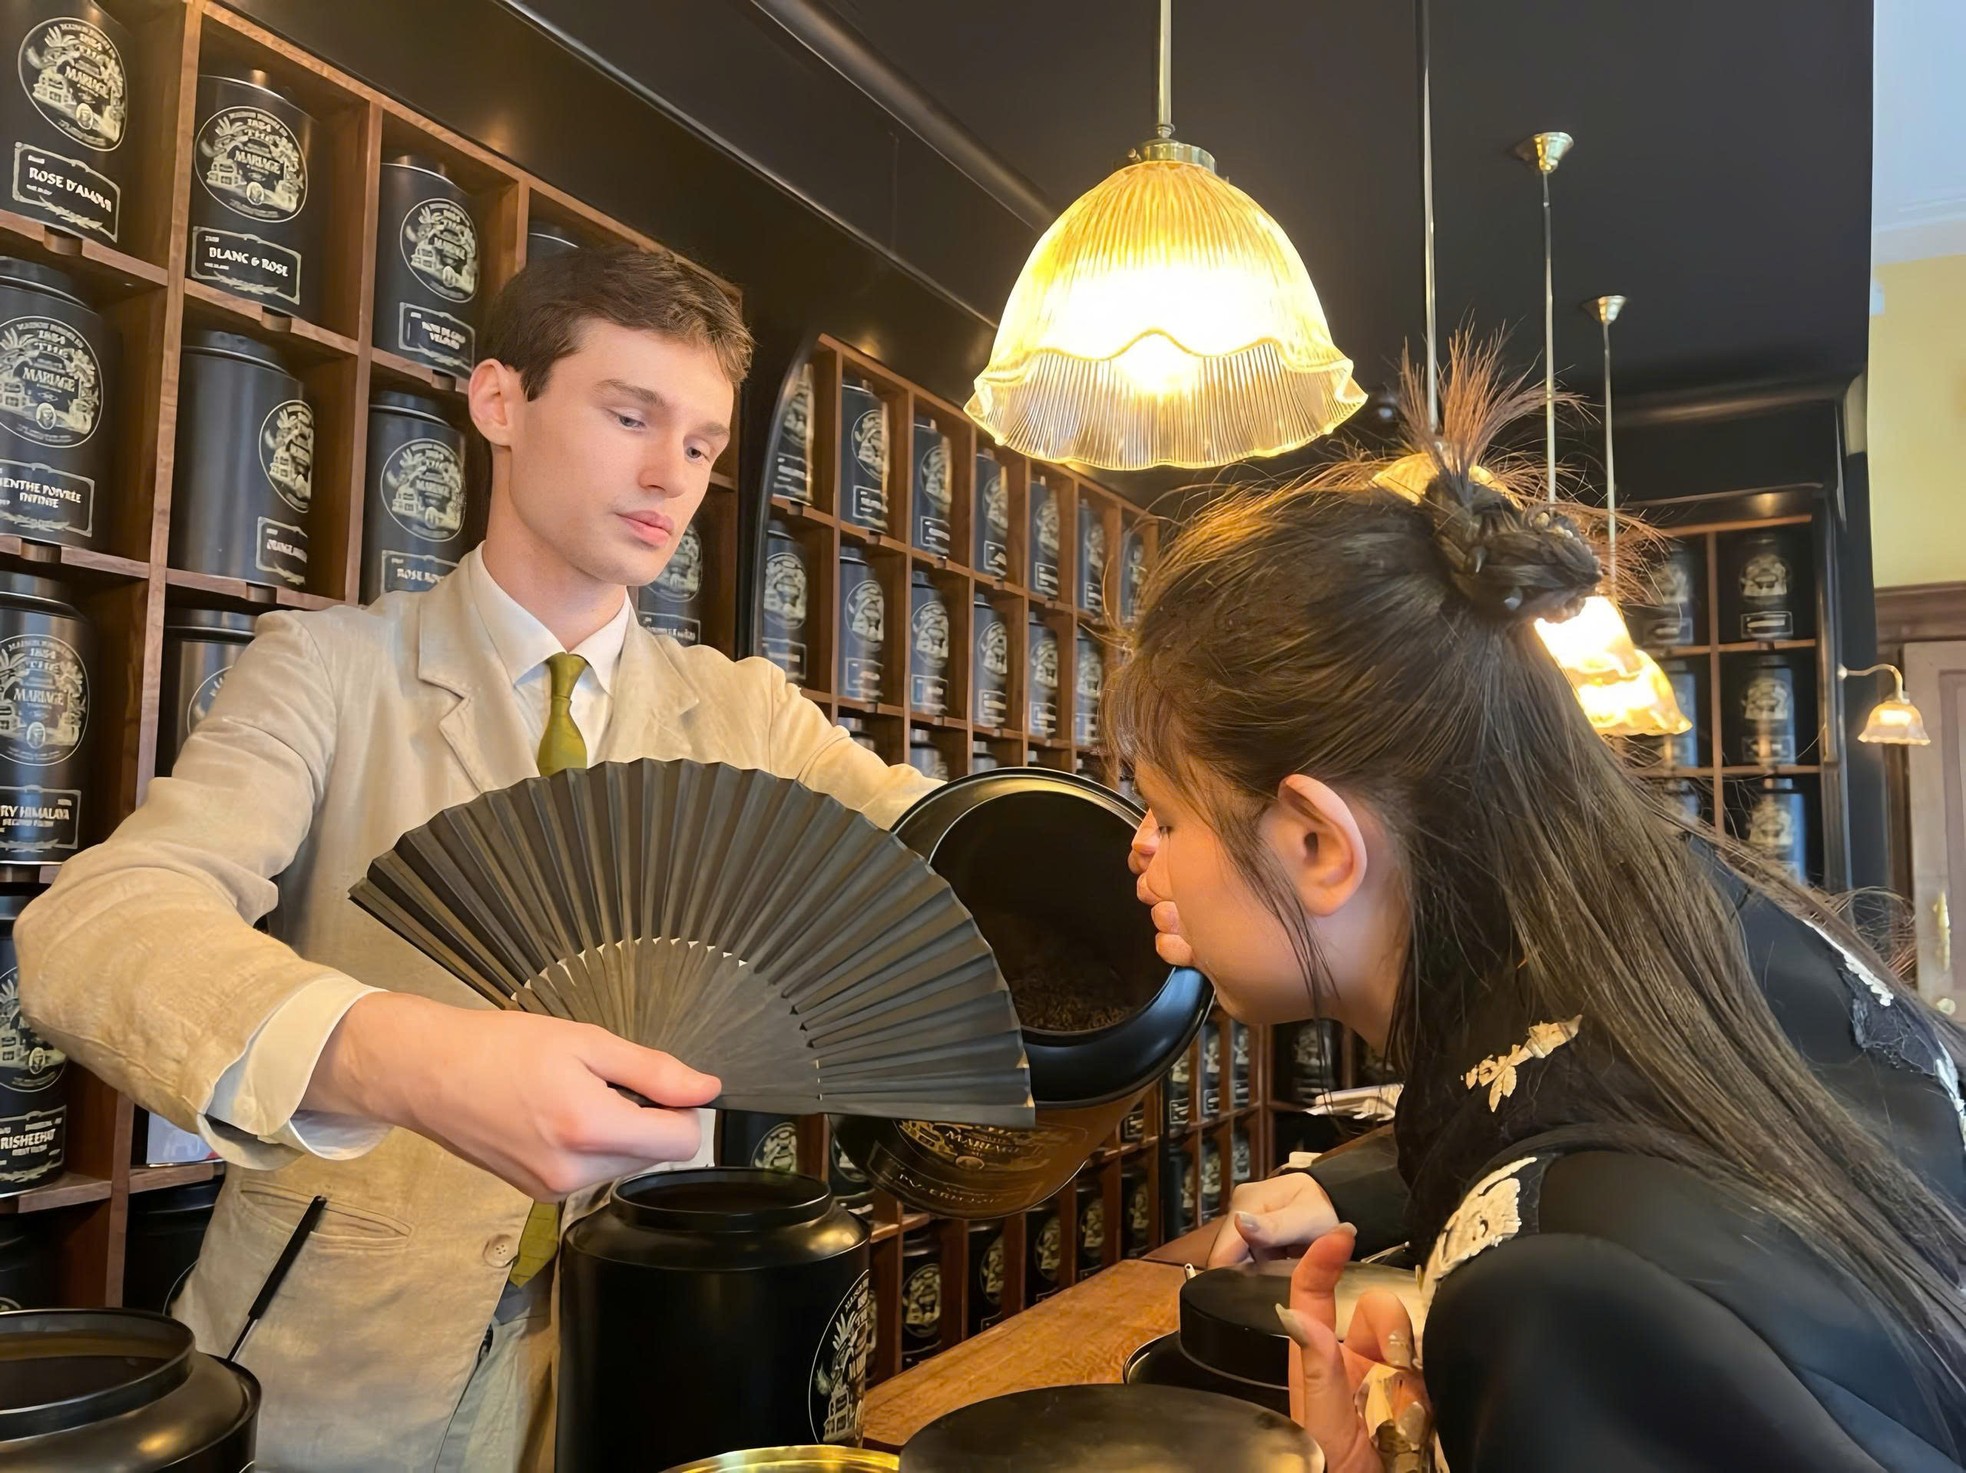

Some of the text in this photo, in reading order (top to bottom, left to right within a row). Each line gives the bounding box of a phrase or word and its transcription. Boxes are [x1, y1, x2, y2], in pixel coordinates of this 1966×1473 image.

[29, 167, 64, 188] ROSE
[209, 247, 249, 263] BLANC
[261, 258, 288, 277] ROSE
[22, 367, 75, 393] MARIAGE
[13, 687, 65, 706] MARIAGE
[19, 810, 70, 825] HIMALAYA
